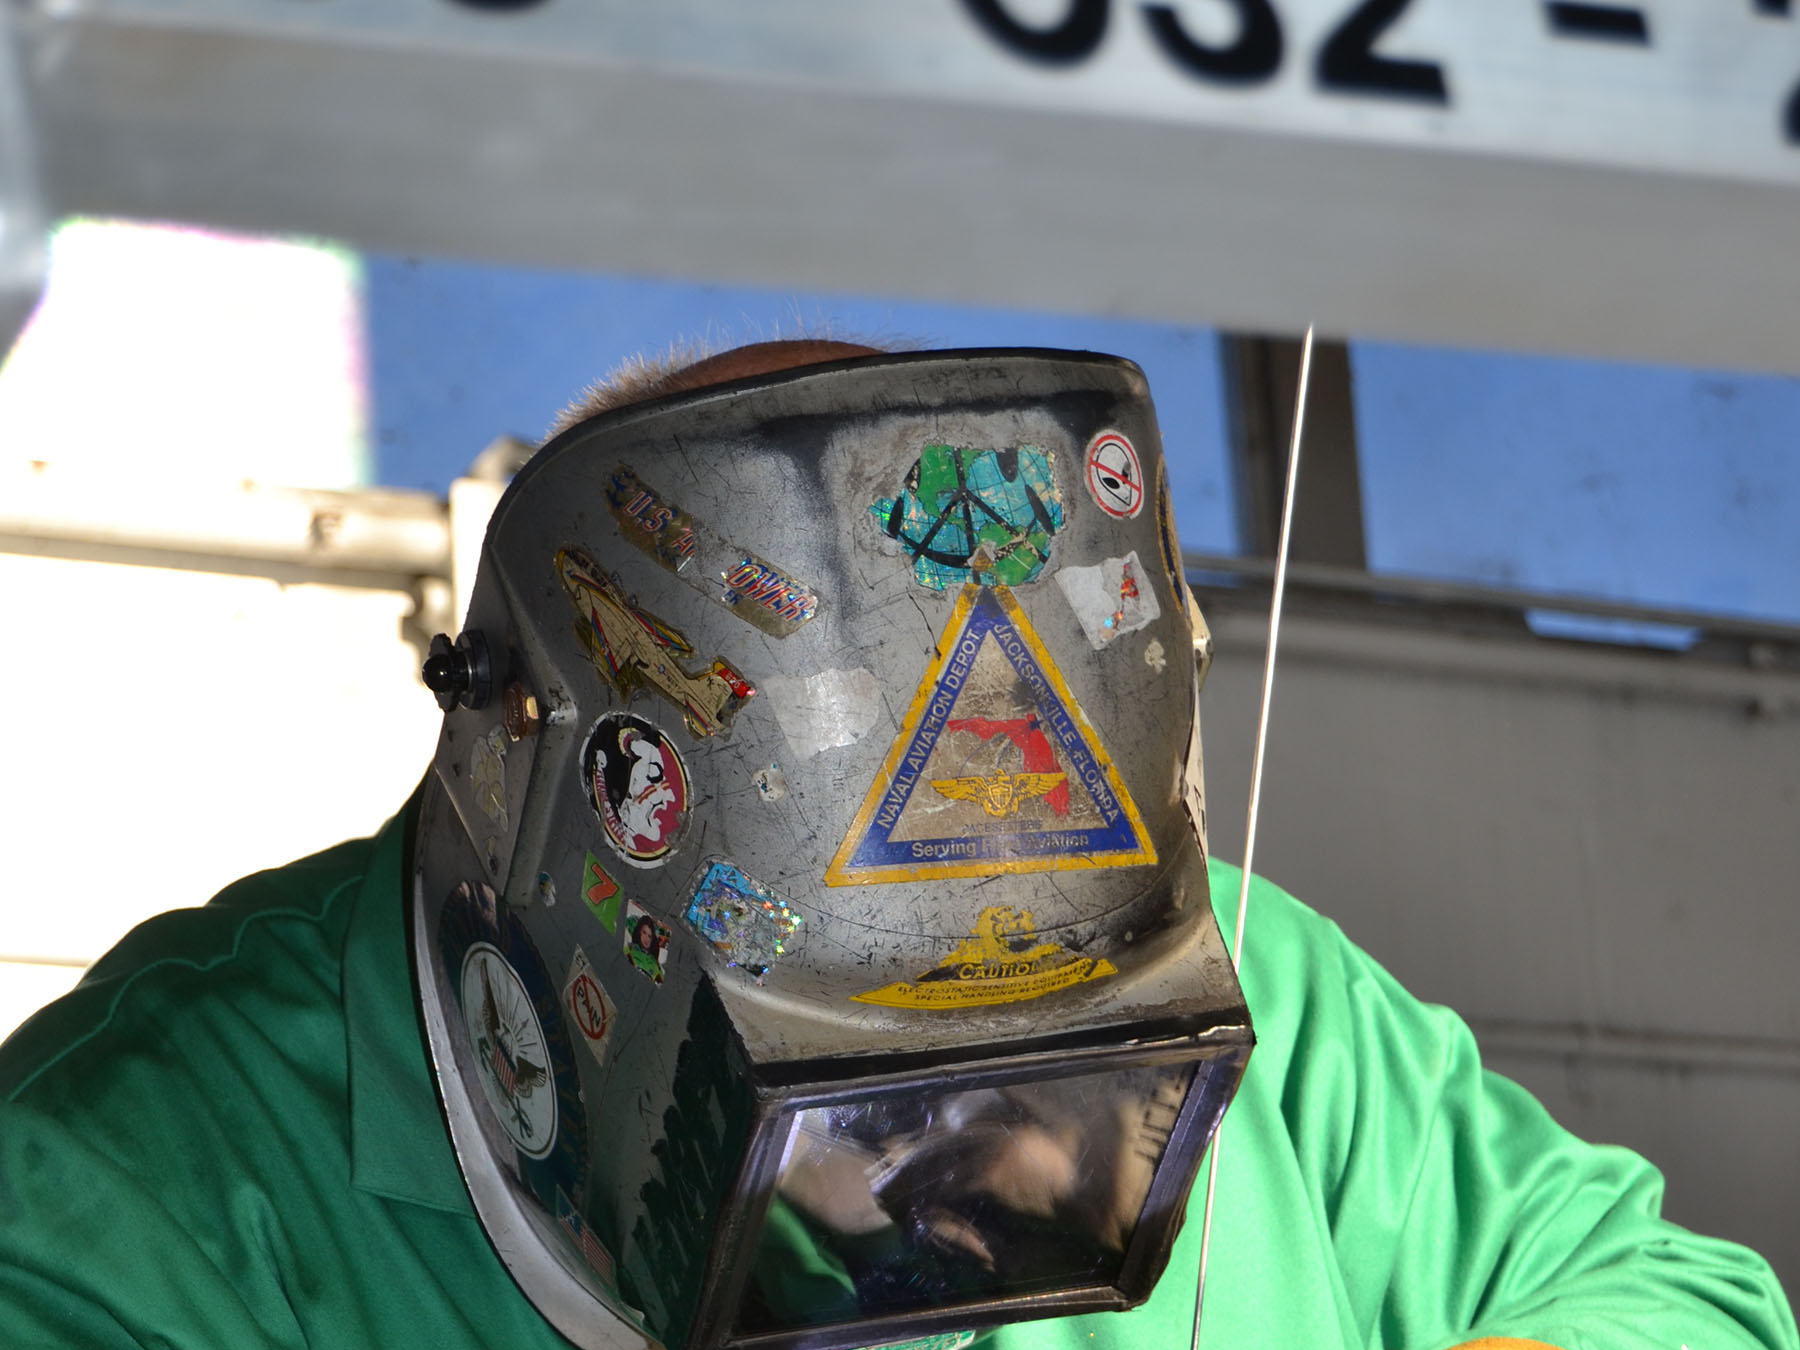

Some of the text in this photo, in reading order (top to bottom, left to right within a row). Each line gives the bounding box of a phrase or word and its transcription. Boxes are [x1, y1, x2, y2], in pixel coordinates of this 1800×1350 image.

[727, 562, 816, 622] OWER
[877, 628, 982, 830] NAVAL AVIATION DEPOT
[911, 840, 977, 859] Serving
[958, 962, 1037, 980] CAUTIO
